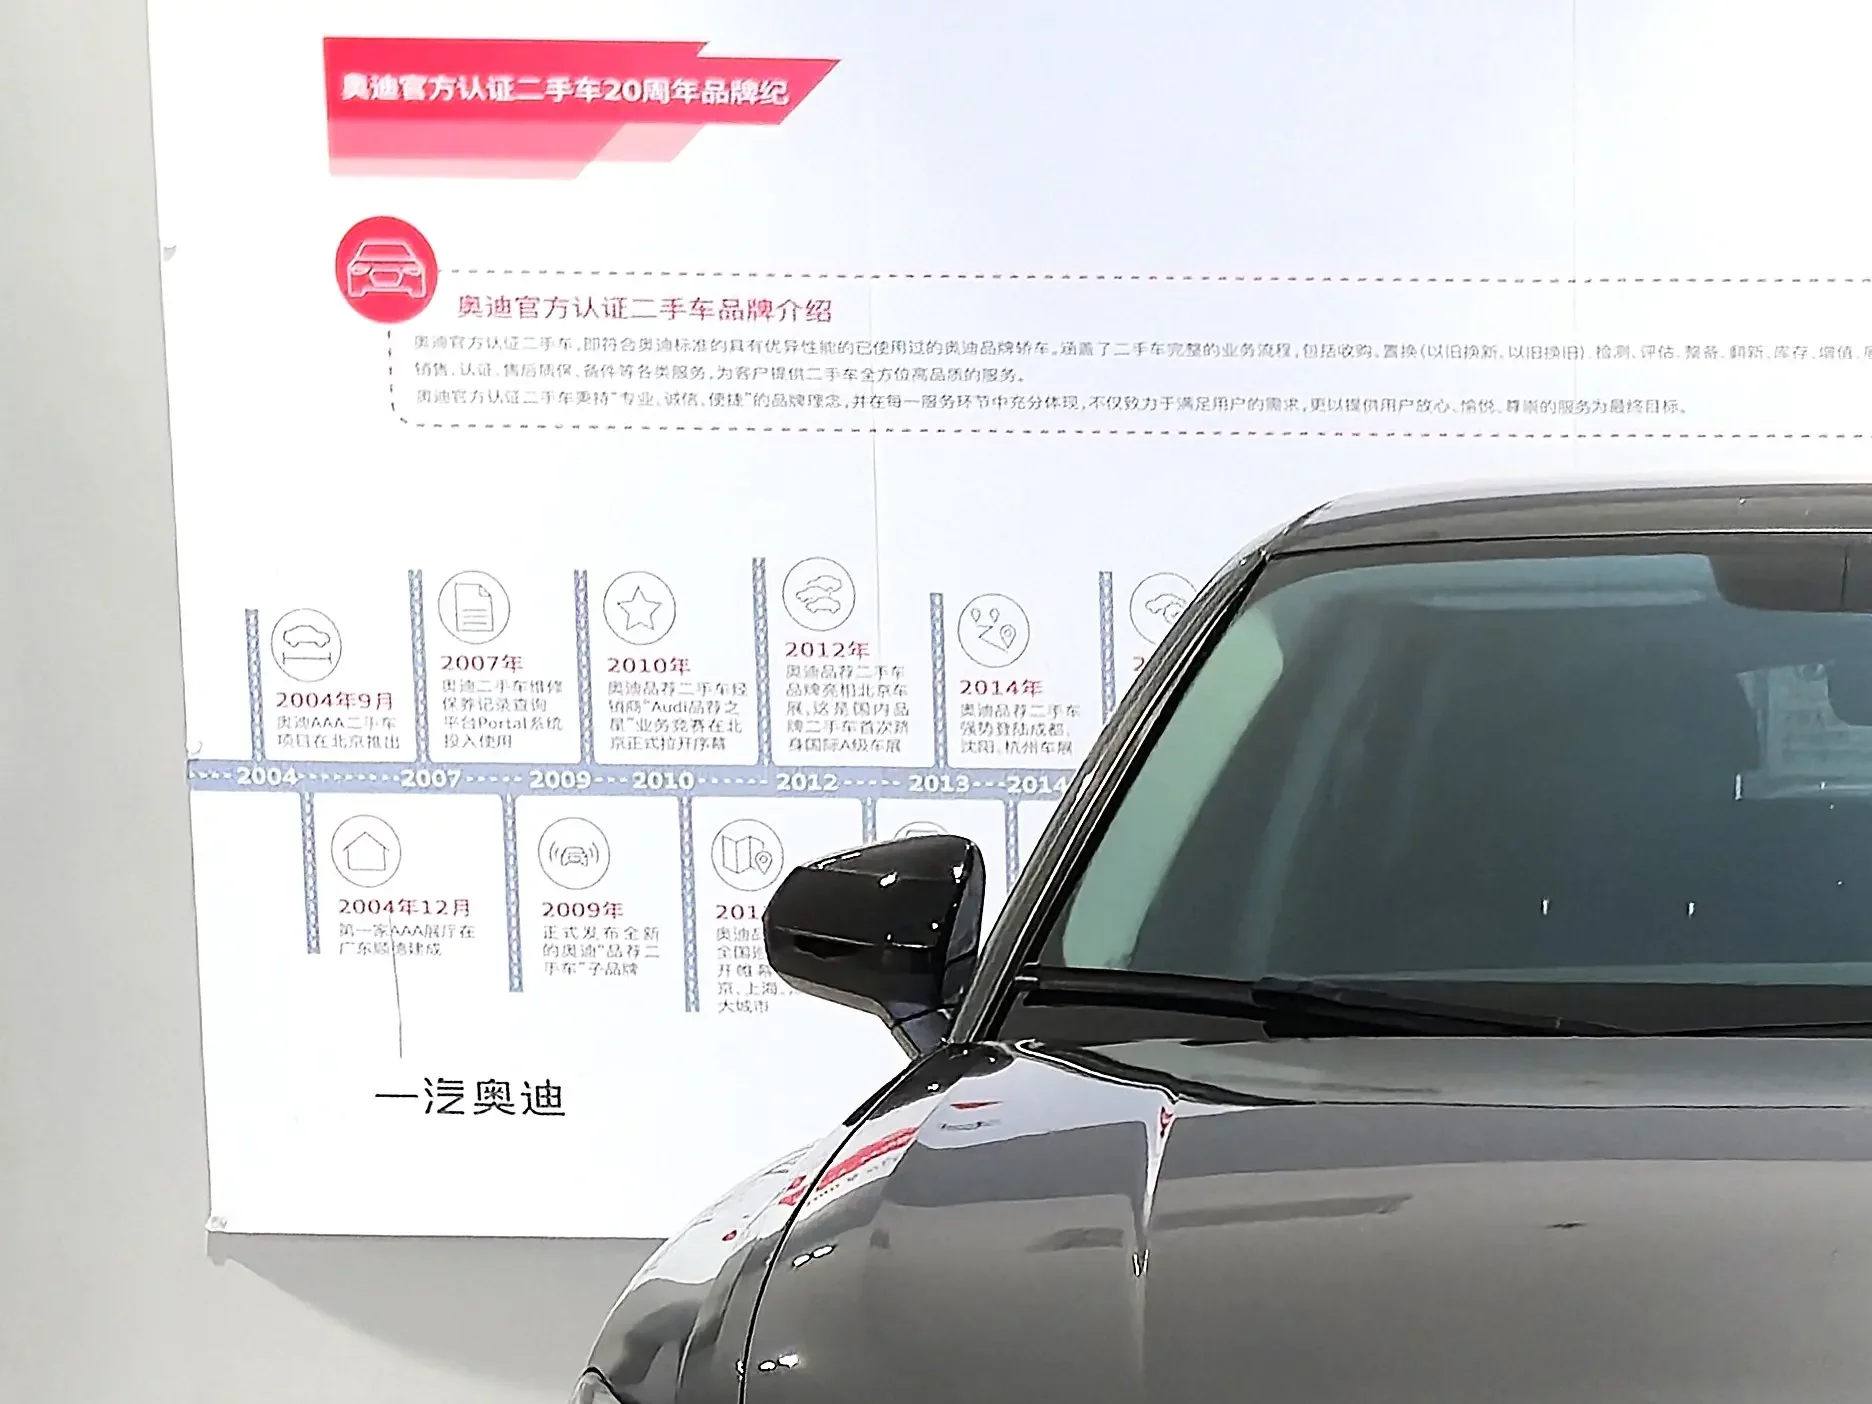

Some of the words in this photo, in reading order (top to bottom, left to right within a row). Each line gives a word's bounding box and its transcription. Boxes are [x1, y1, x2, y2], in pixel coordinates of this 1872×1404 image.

[341, 73, 790, 106] 奥迪官方认证二手车20周年品牌纪
[457, 296, 834, 323] 奥迪官方认证二手车品牌介绍
[784, 641, 870, 659] 2012年
[440, 655, 523, 673] 2007年
[607, 657, 691, 675] 2010年
[959, 679, 1043, 697] 2014年
[275, 691, 393, 710] 2004年9月
[237, 767, 299, 786] 2004
[401, 769, 461, 787] 2007
[529, 770, 592, 789] 2009
[632, 771, 695, 790] 2010
[776, 773, 838, 792] 2012
[909, 775, 970, 794] 2013
[1007, 776, 1068, 794] 2014
[338, 898, 471, 917] 2004年12月
[541, 901, 624, 919] 2009年
[716, 904, 767, 919] 201
[375, 1077, 565, 1116] 一汽奥迪
